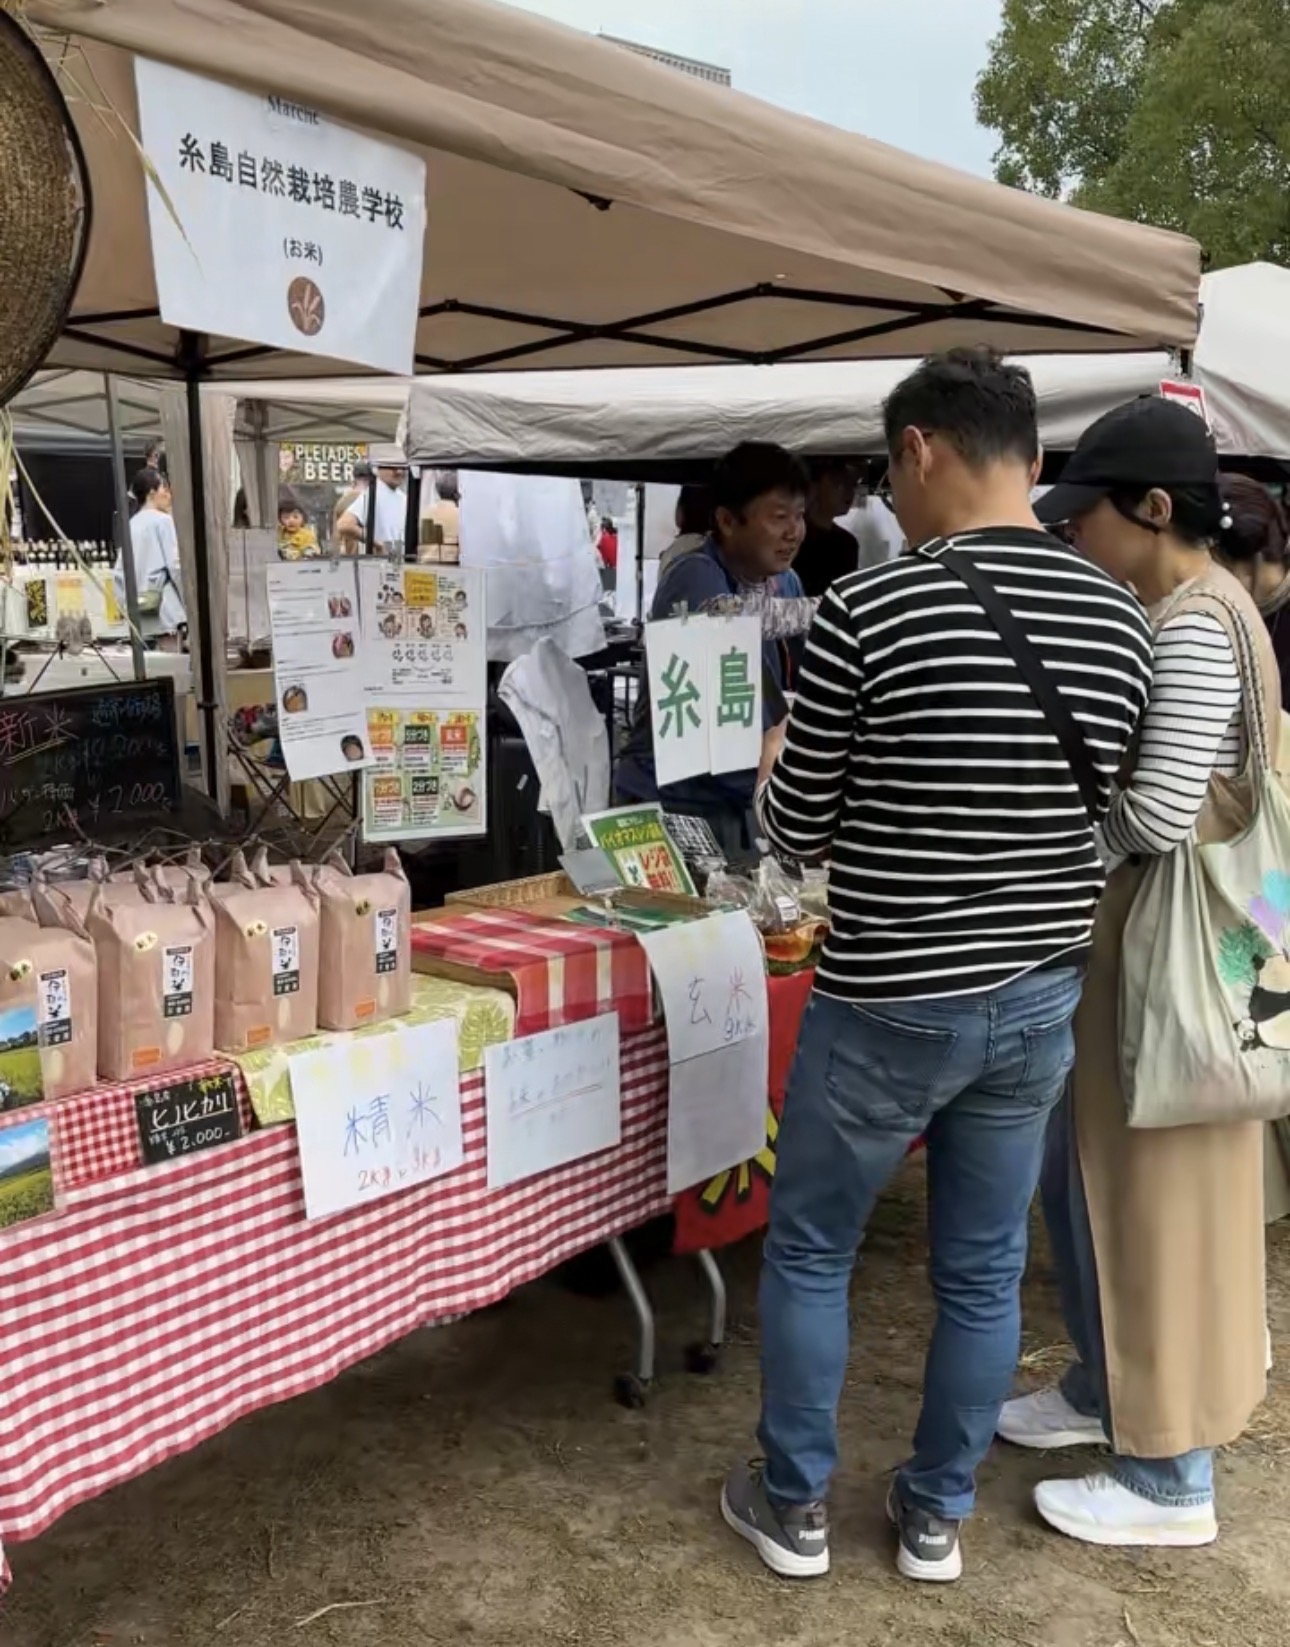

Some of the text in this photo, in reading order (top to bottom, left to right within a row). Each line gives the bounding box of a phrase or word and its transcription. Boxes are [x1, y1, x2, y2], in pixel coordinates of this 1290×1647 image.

[178, 131, 405, 231] 糸島自然栽培農学校
[283, 237, 324, 266] (お米)
[295, 443, 363, 462] PLEIADES
[304, 462, 356, 482] BEER
[657, 645, 756, 738] 糸島
[0, 702, 79, 754] 新米
[152, 1091, 230, 1129] ヒノヒカリ
[343, 1080, 445, 1157] 精米
